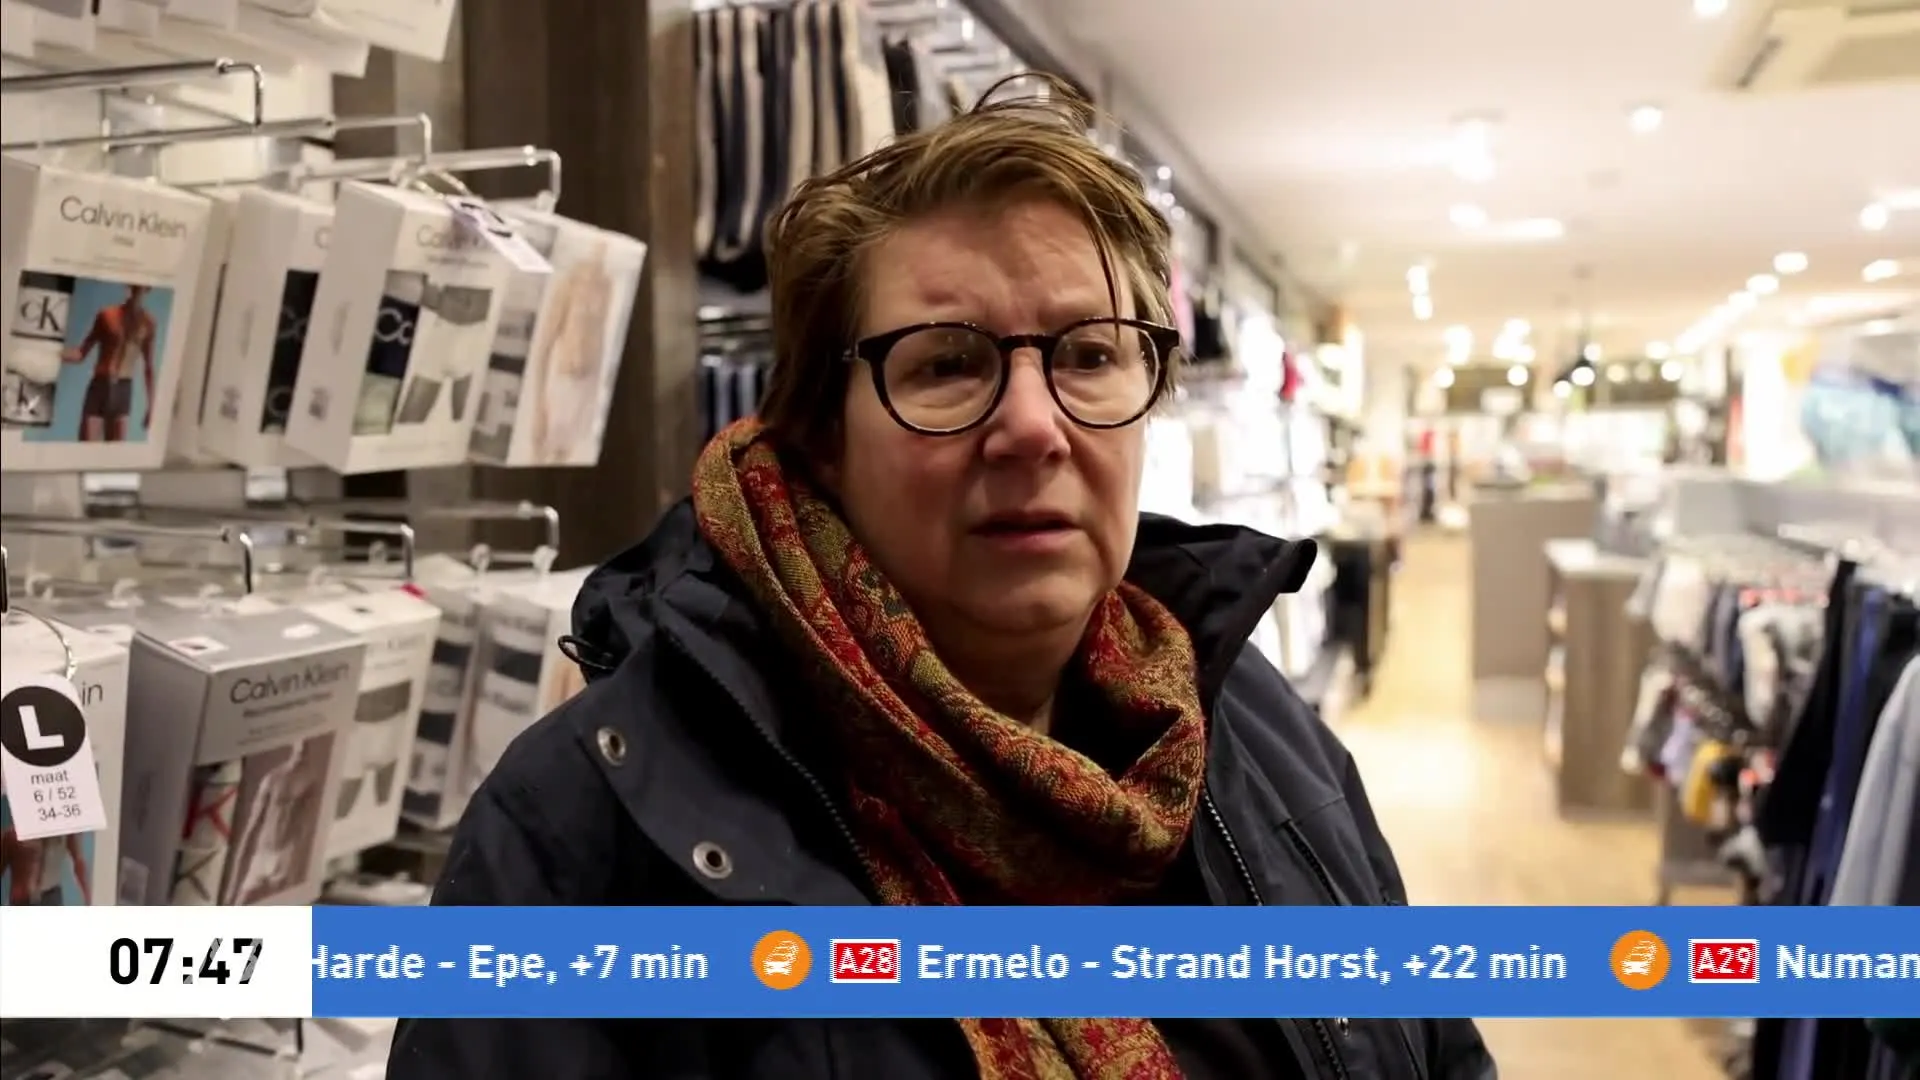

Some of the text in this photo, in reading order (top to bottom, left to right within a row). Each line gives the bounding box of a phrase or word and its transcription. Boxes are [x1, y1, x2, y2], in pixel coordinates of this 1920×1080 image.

[60, 195, 187, 240] Calvin Klein
[229, 673, 301, 705] Calvin
[302, 661, 350, 690] Klein
[18, 704, 65, 751] L
[30, 769, 70, 786] maat
[33, 789, 44, 803] 6
[57, 785, 77, 801] 52
[37, 803, 82, 822] 34-36
